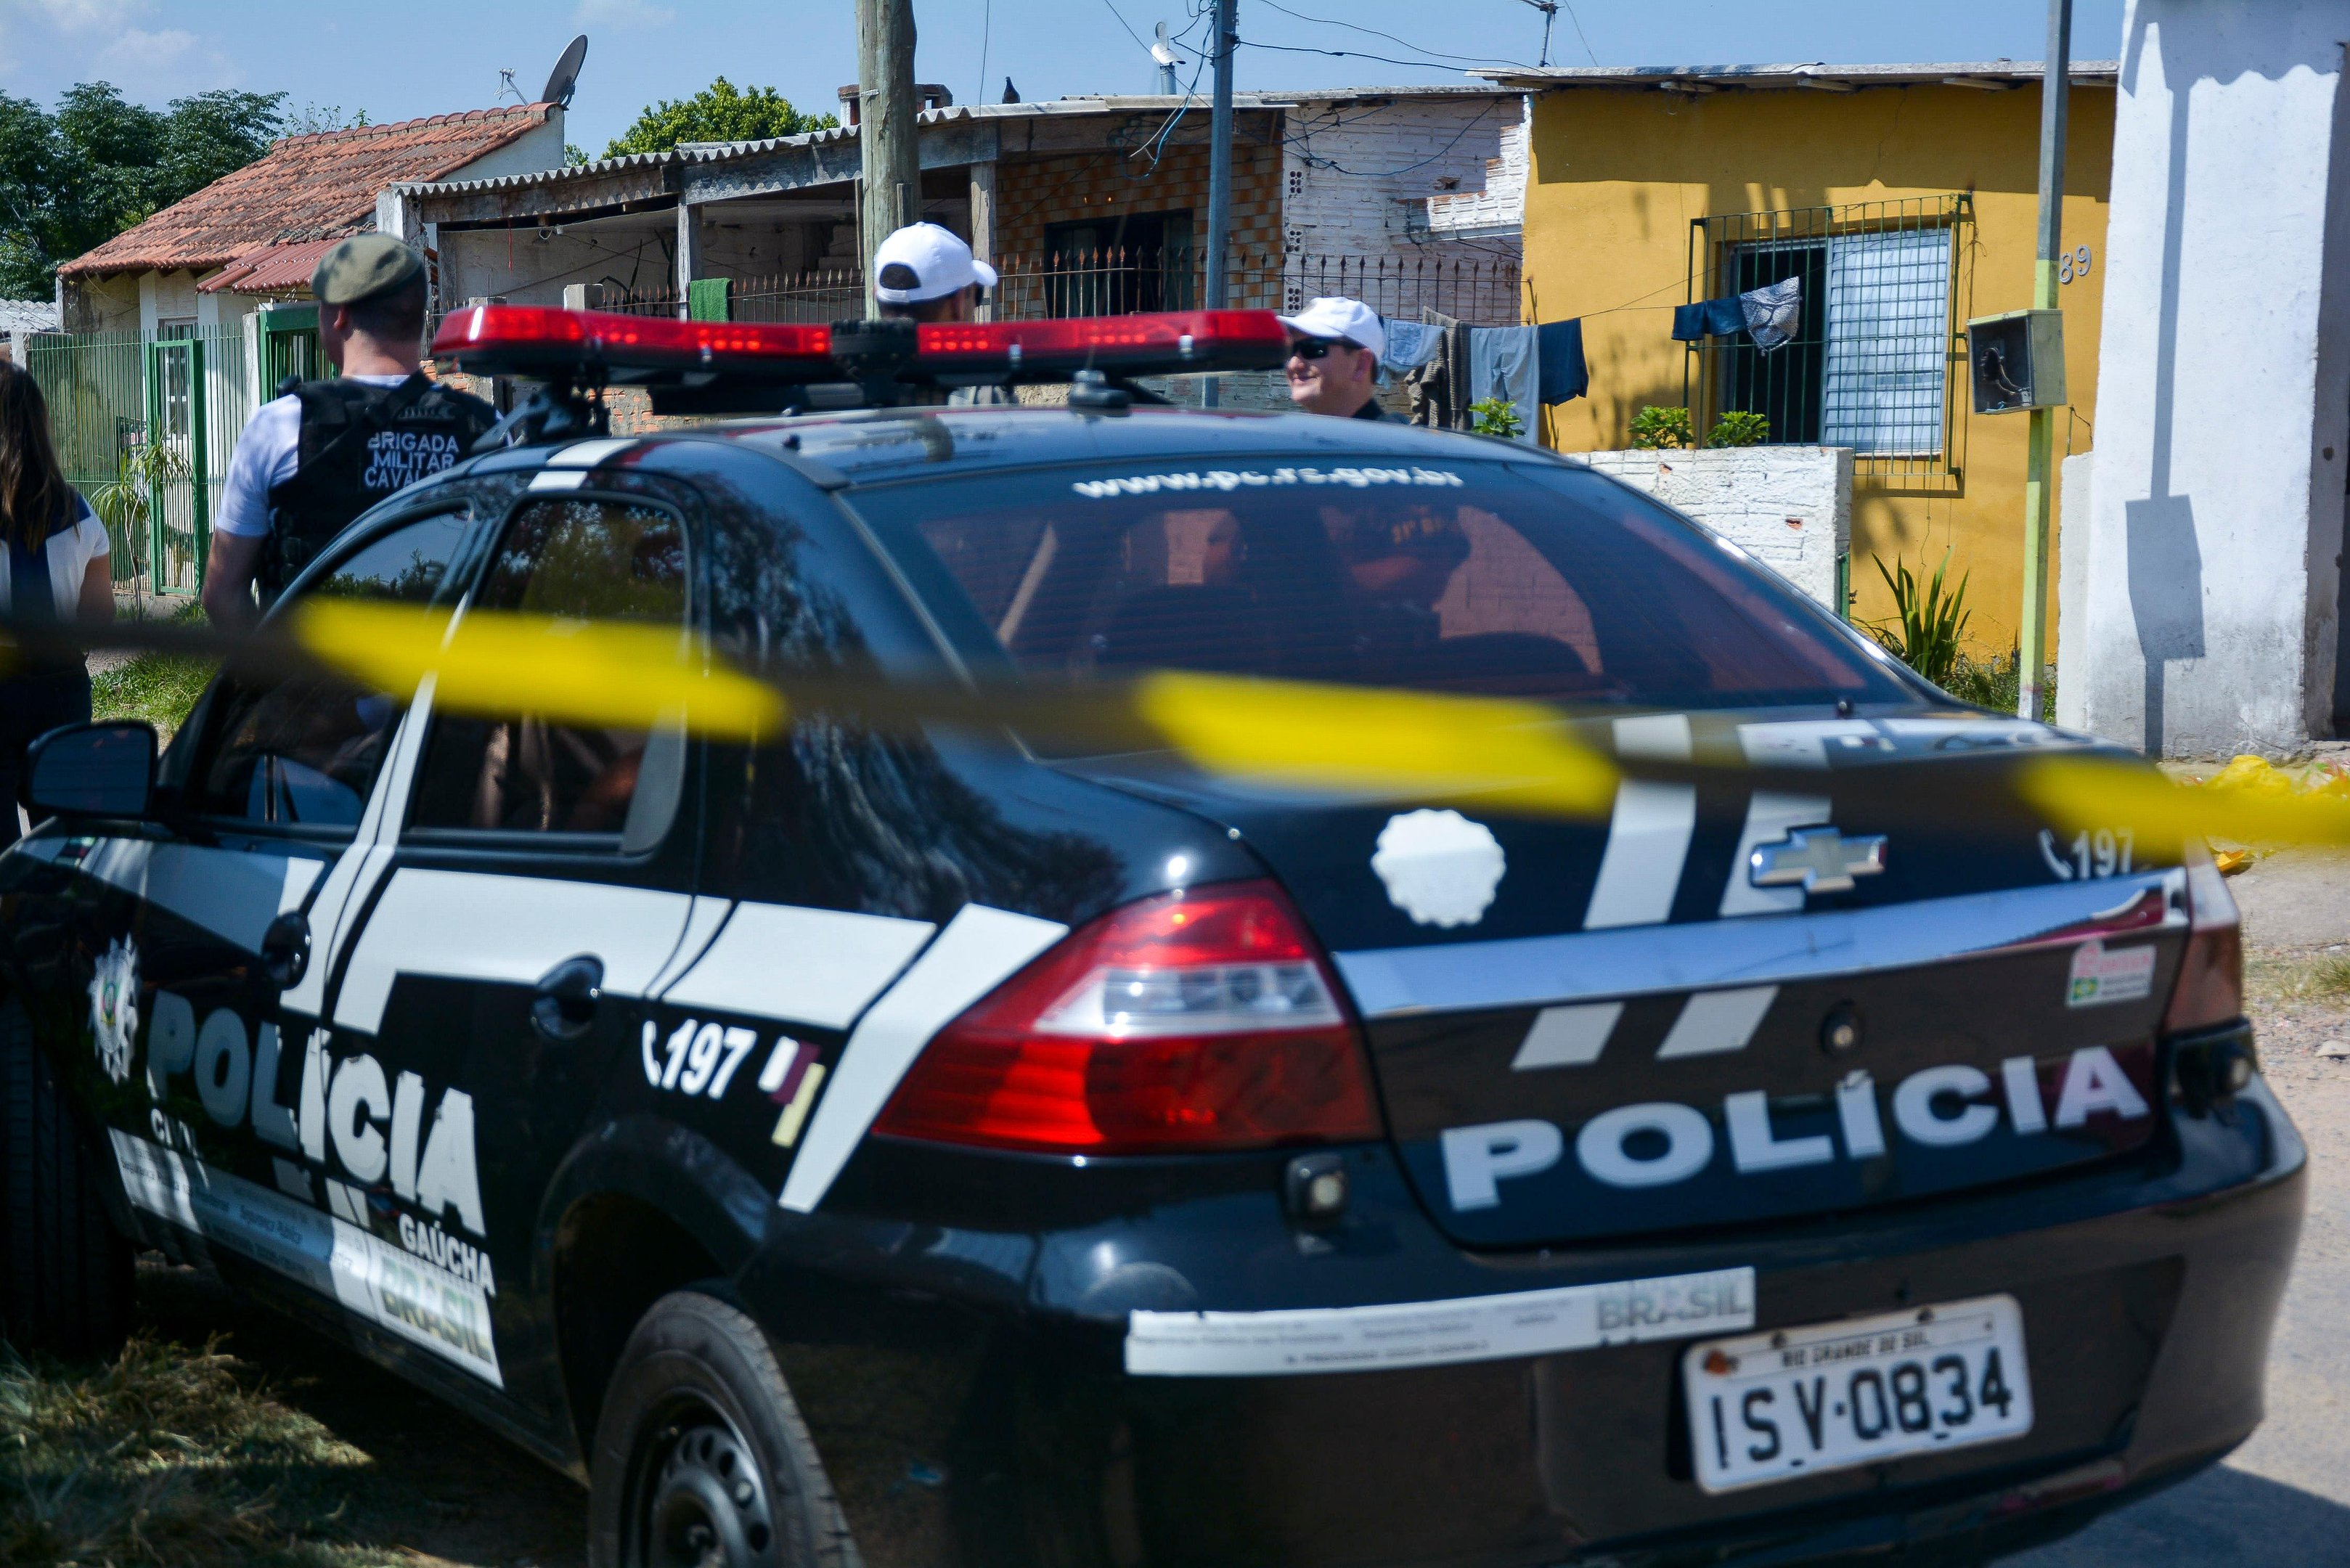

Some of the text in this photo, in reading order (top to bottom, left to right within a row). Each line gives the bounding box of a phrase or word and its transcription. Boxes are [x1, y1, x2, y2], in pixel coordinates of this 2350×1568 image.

[2059, 244, 2092, 285] 89
[367, 431, 460, 453] BRIGADA
[373, 450, 455, 471] MILITAR
[2071, 826, 2134, 879] 197
[661, 1018, 756, 1101] 197
[147, 989, 486, 1237] POLÍCIA
[1441, 1045, 2150, 1212] POLÍCIA
[399, 1213, 497, 1297] GAÚCHA
[1598, 1281, 1747, 1331] BRASIL
